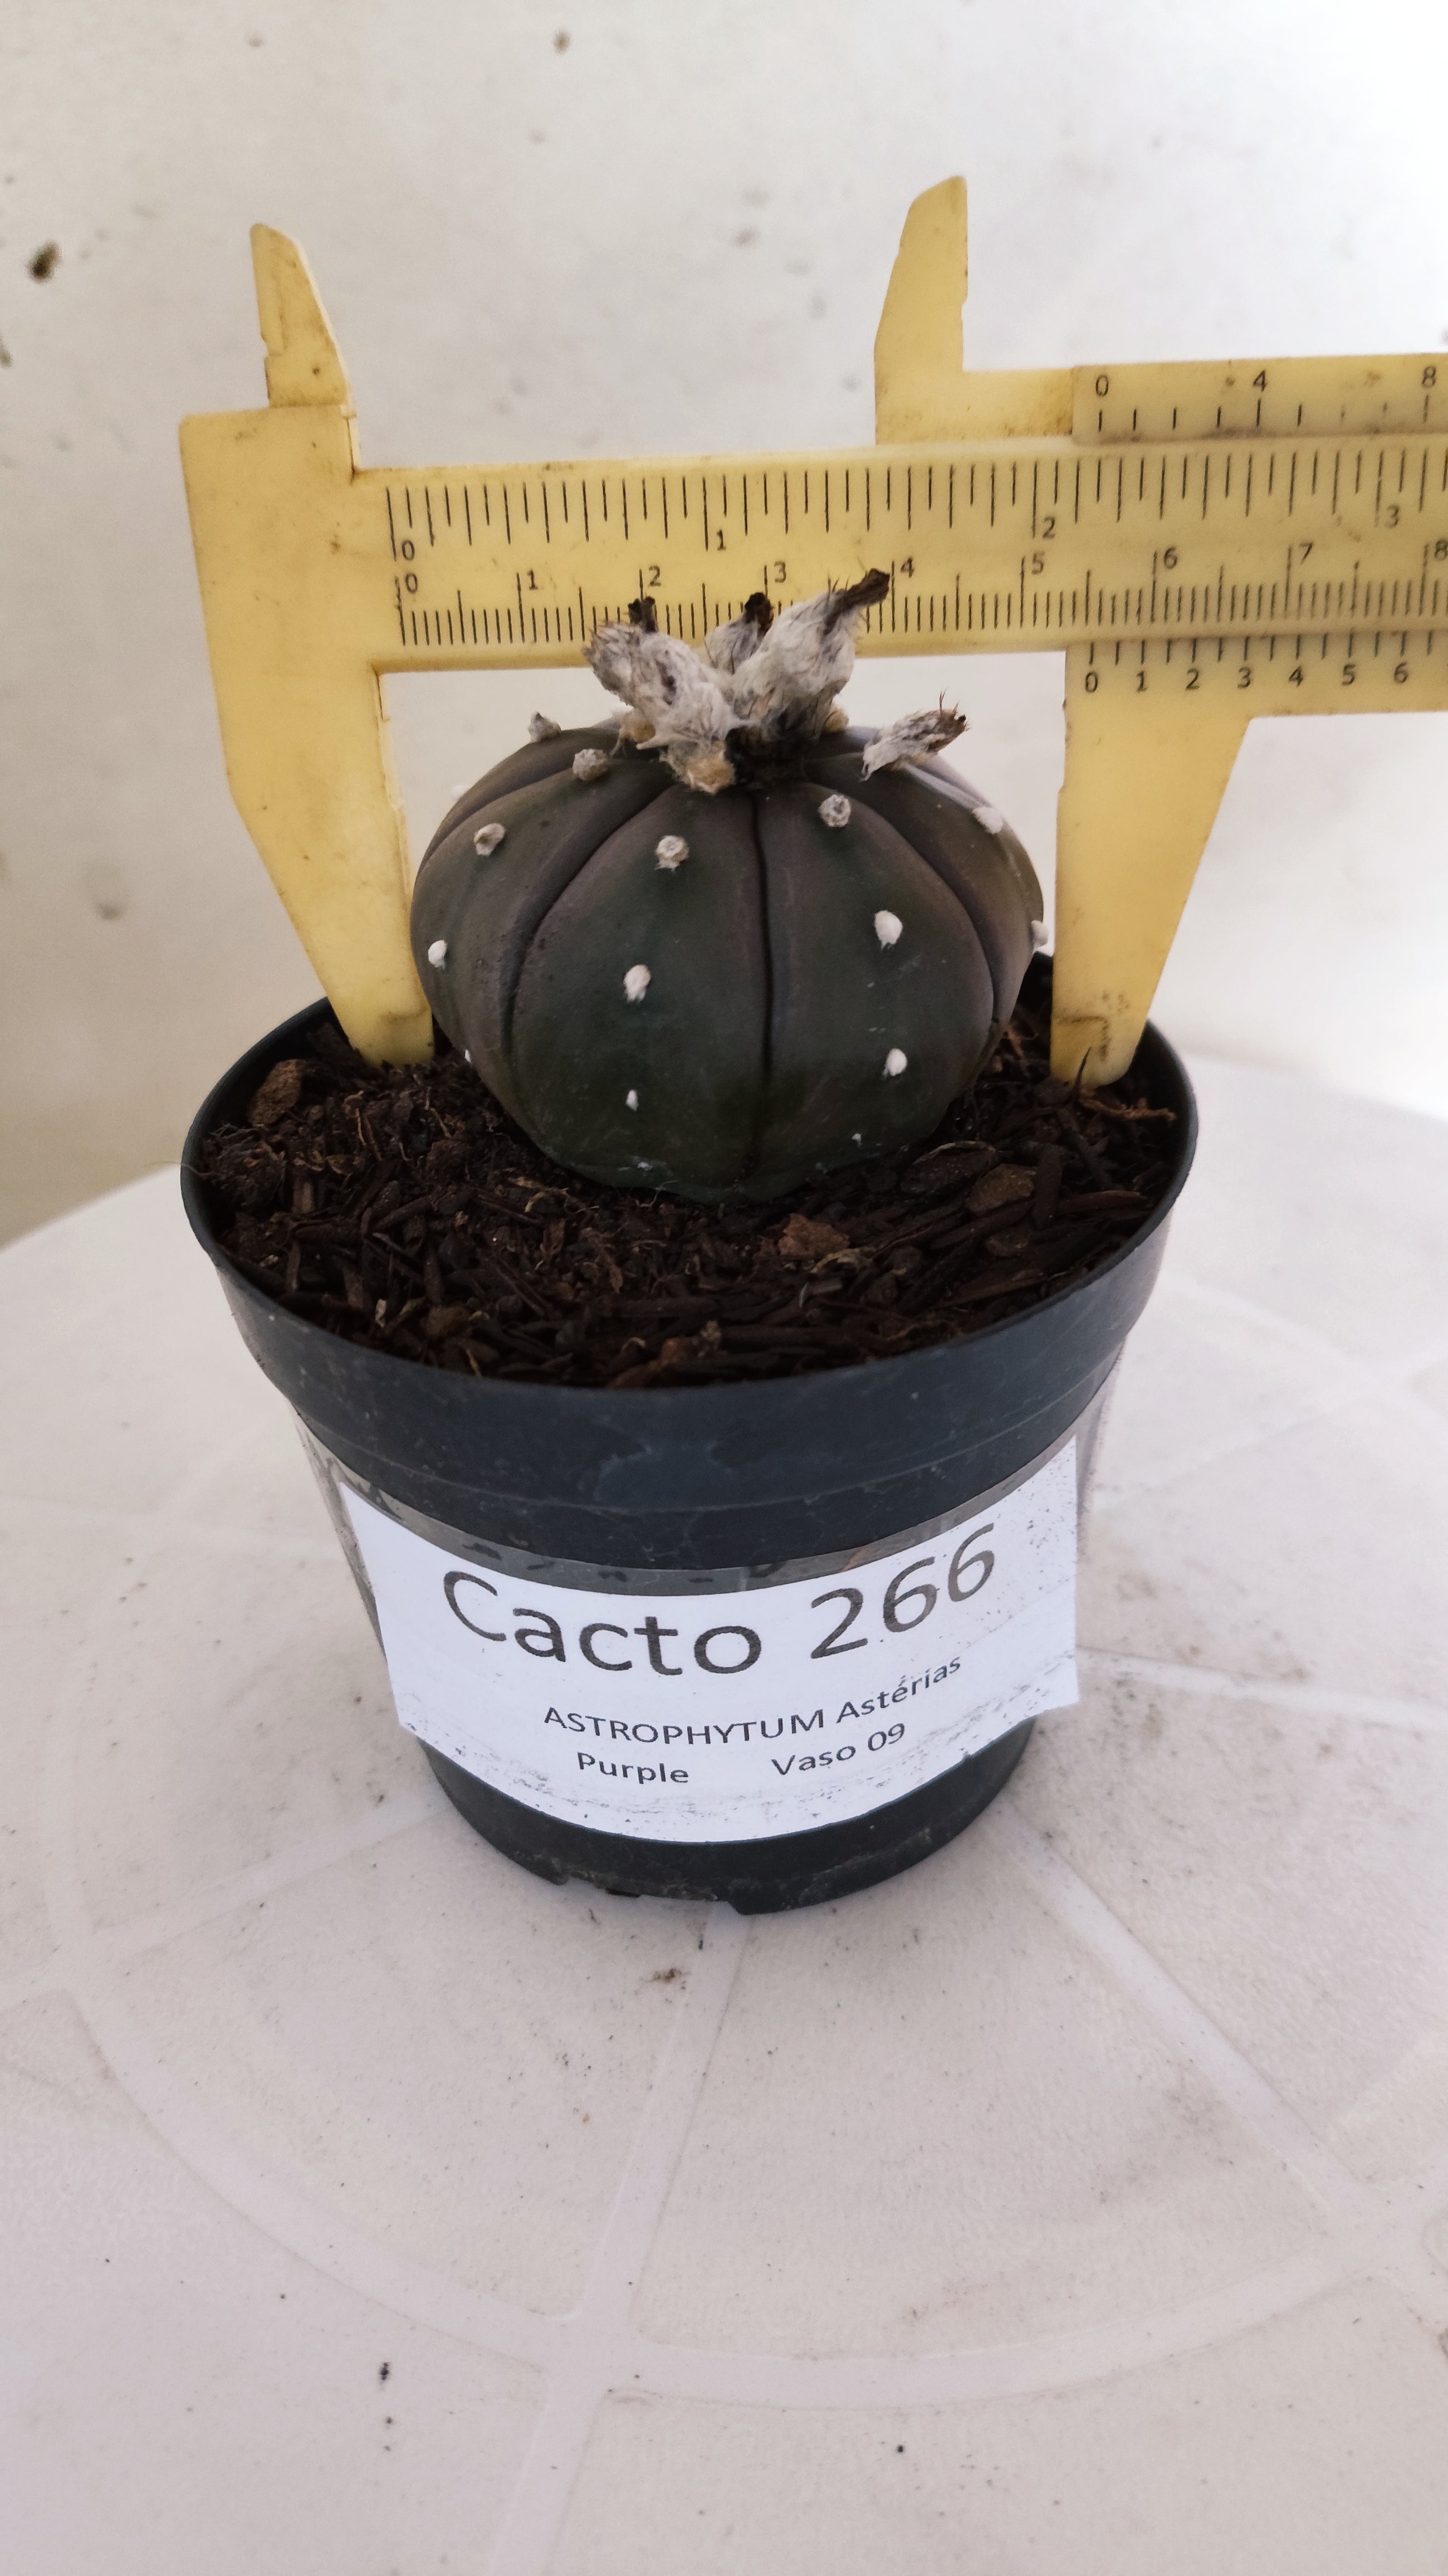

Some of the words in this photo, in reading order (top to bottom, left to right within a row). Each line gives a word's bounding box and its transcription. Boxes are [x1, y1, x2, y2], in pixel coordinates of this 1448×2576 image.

[1095, 375, 1110, 397] 0
[1253, 369, 1268, 392] 4
[1421, 365, 1437, 387] 8
[400, 539, 416, 561] 0
[716, 529, 727, 551] 1
[1041, 516, 1056, 539] 2
[1386, 504, 1401, 528] 3
[404, 572, 418, 594] 0
[527, 569, 539, 591] 1
[648, 564, 662, 587] 2
[774, 560, 787, 584] 3
[899, 557, 915, 578] 4
[1031, 552, 1045, 575] 5
[1162, 546, 1178, 570] 6
[1300, 541, 1314, 561] 7
[1434, 539, 1448, 561] 8
[1084, 671, 1099, 693] 0
[1136, 670, 1147, 692] 1
[1185, 667, 1200, 690] 2
[1237, 666, 1252, 689] 3
[1288, 666, 1304, 687] 4
[1341, 663, 1357, 686] 5
[1393, 661, 1409, 684] 6
[443, 1570, 764, 1676] Cacto
[809, 1521, 996, 1661] 266
[543, 1705, 825, 1746] ASTROPHYTUM
[835, 1655, 962, 1725] Astérias
[576, 1750, 690, 1785] Purple
[771, 1744, 857, 1777] Vaso
[867, 1722, 906, 1753] 09
